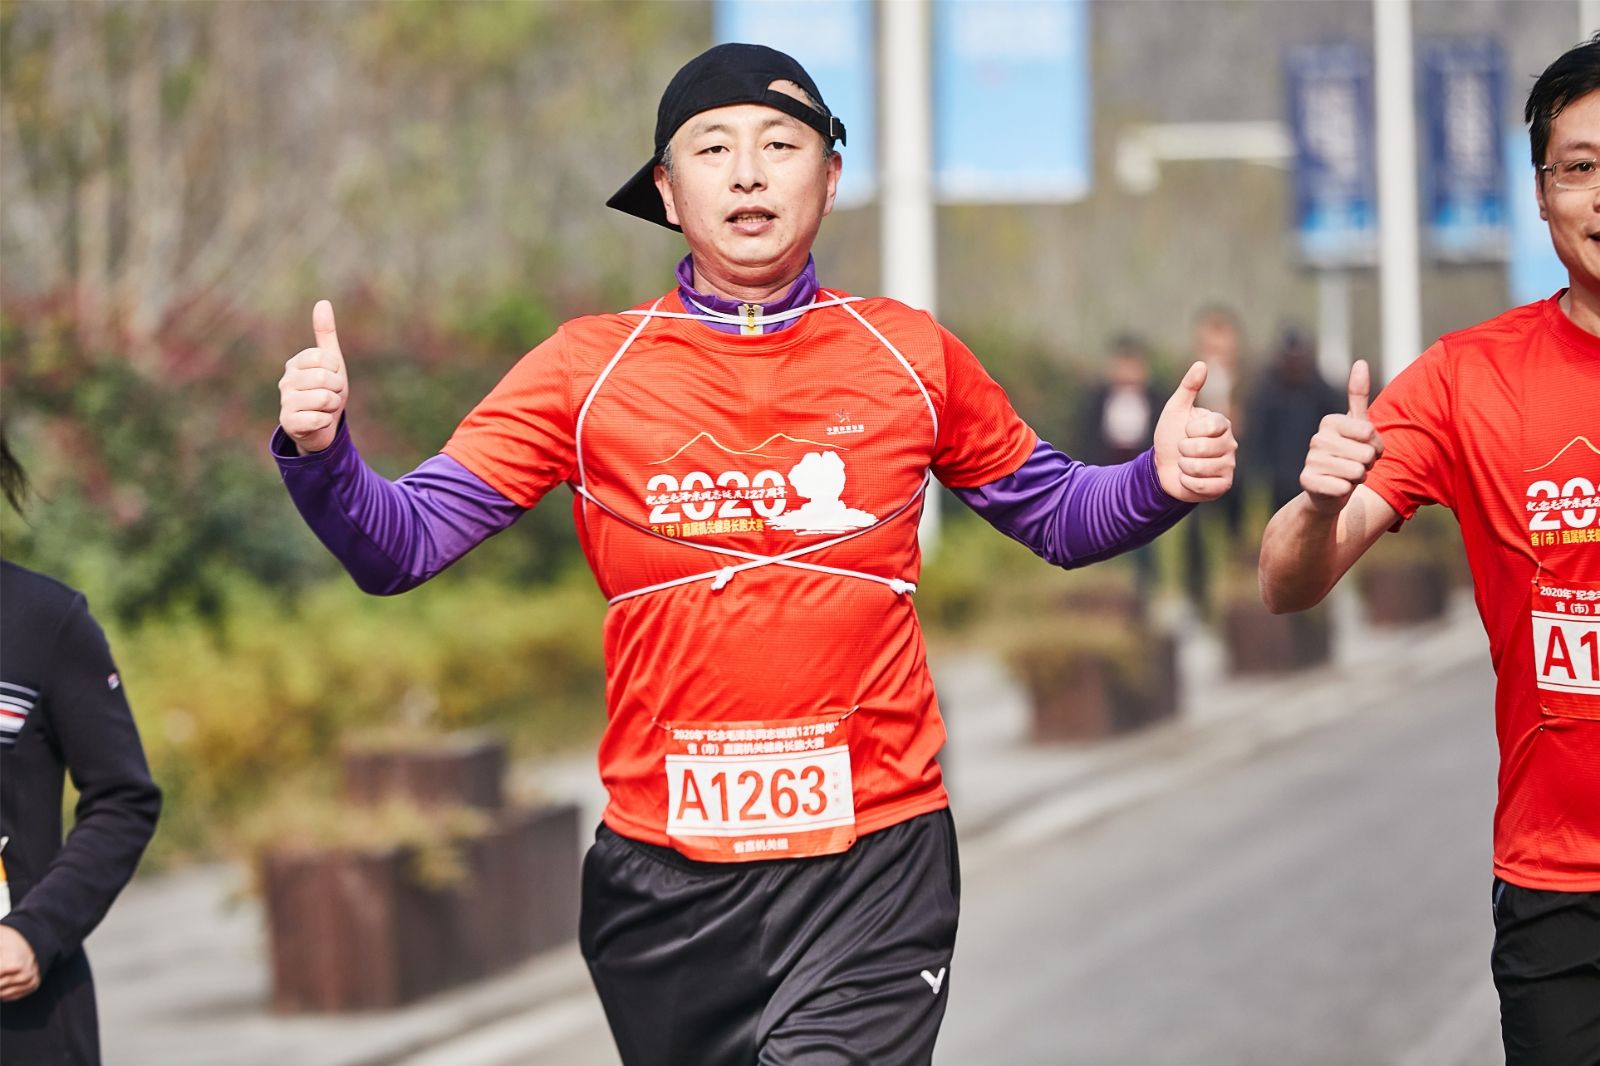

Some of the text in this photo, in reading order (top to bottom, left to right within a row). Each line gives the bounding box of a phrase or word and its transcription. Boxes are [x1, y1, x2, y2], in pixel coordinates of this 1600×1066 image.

[646, 470, 787, 524] 2020
[1526, 476, 1600, 531] 20
[1542, 625, 1600, 681] A1
[675, 765, 828, 822] A1263
